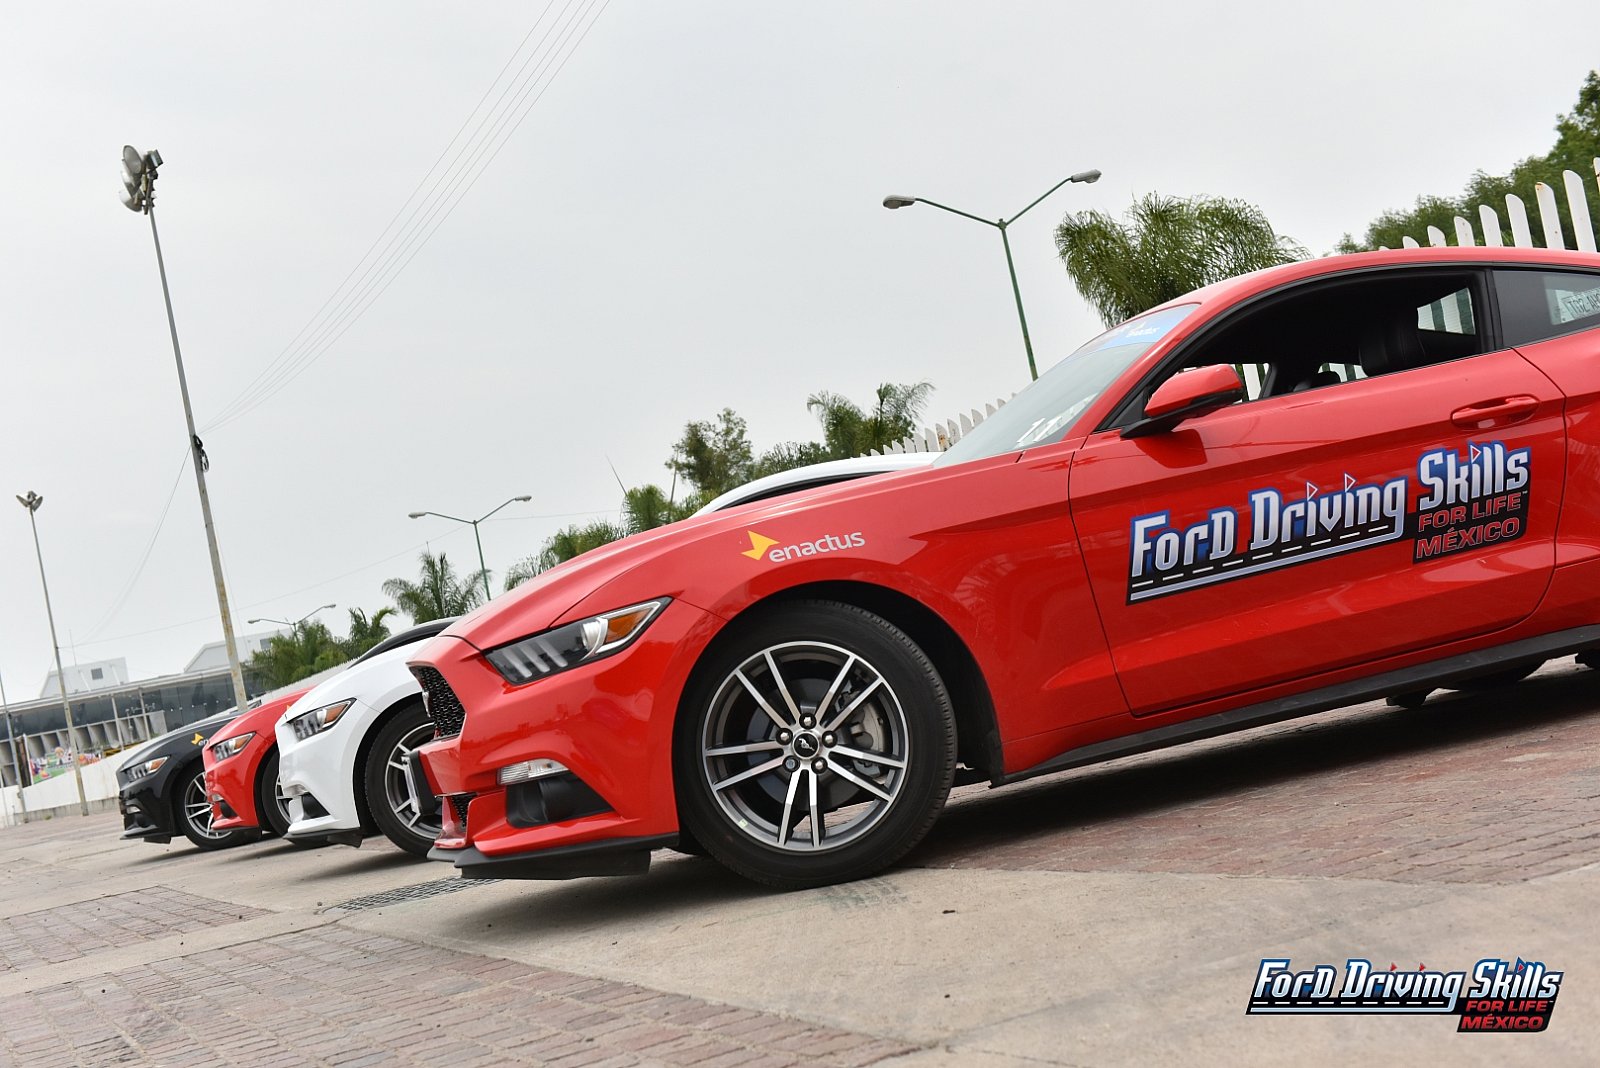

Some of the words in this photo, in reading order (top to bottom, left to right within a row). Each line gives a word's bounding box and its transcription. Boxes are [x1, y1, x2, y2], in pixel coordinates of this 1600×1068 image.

[1249, 473, 1406, 551] Driving
[1419, 443, 1529, 511] Skills
[1418, 506, 1467, 532] FOR
[768, 531, 866, 563] enactus
[1416, 517, 1520, 559] MÉXICO
